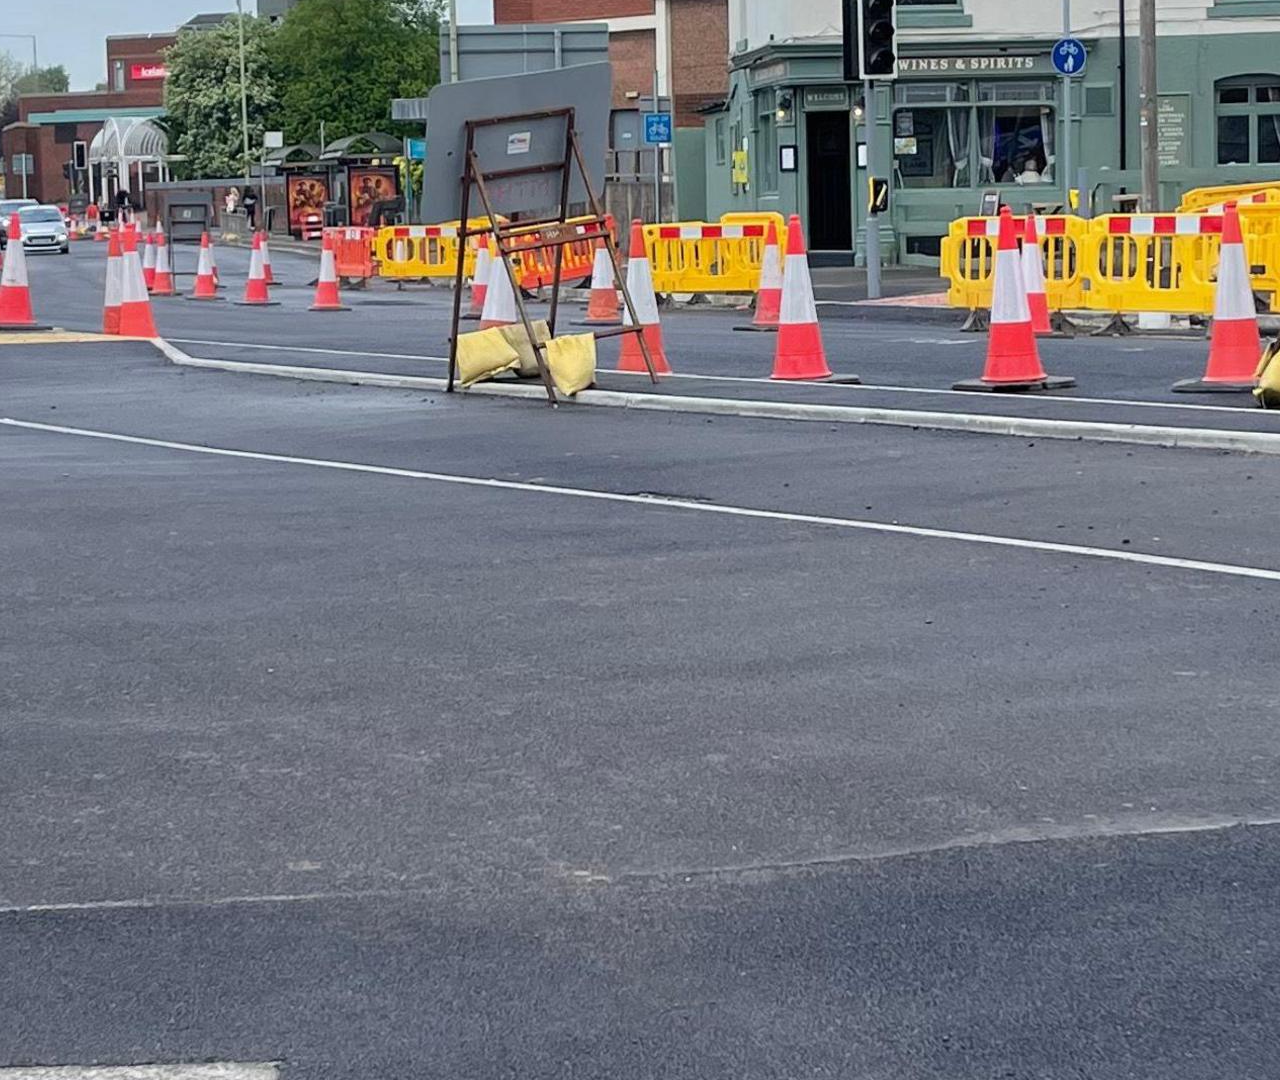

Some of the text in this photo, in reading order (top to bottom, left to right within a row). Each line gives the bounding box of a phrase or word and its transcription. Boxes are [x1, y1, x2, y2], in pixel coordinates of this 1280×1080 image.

[898, 57, 1034, 71] WINES & SPIRITS
